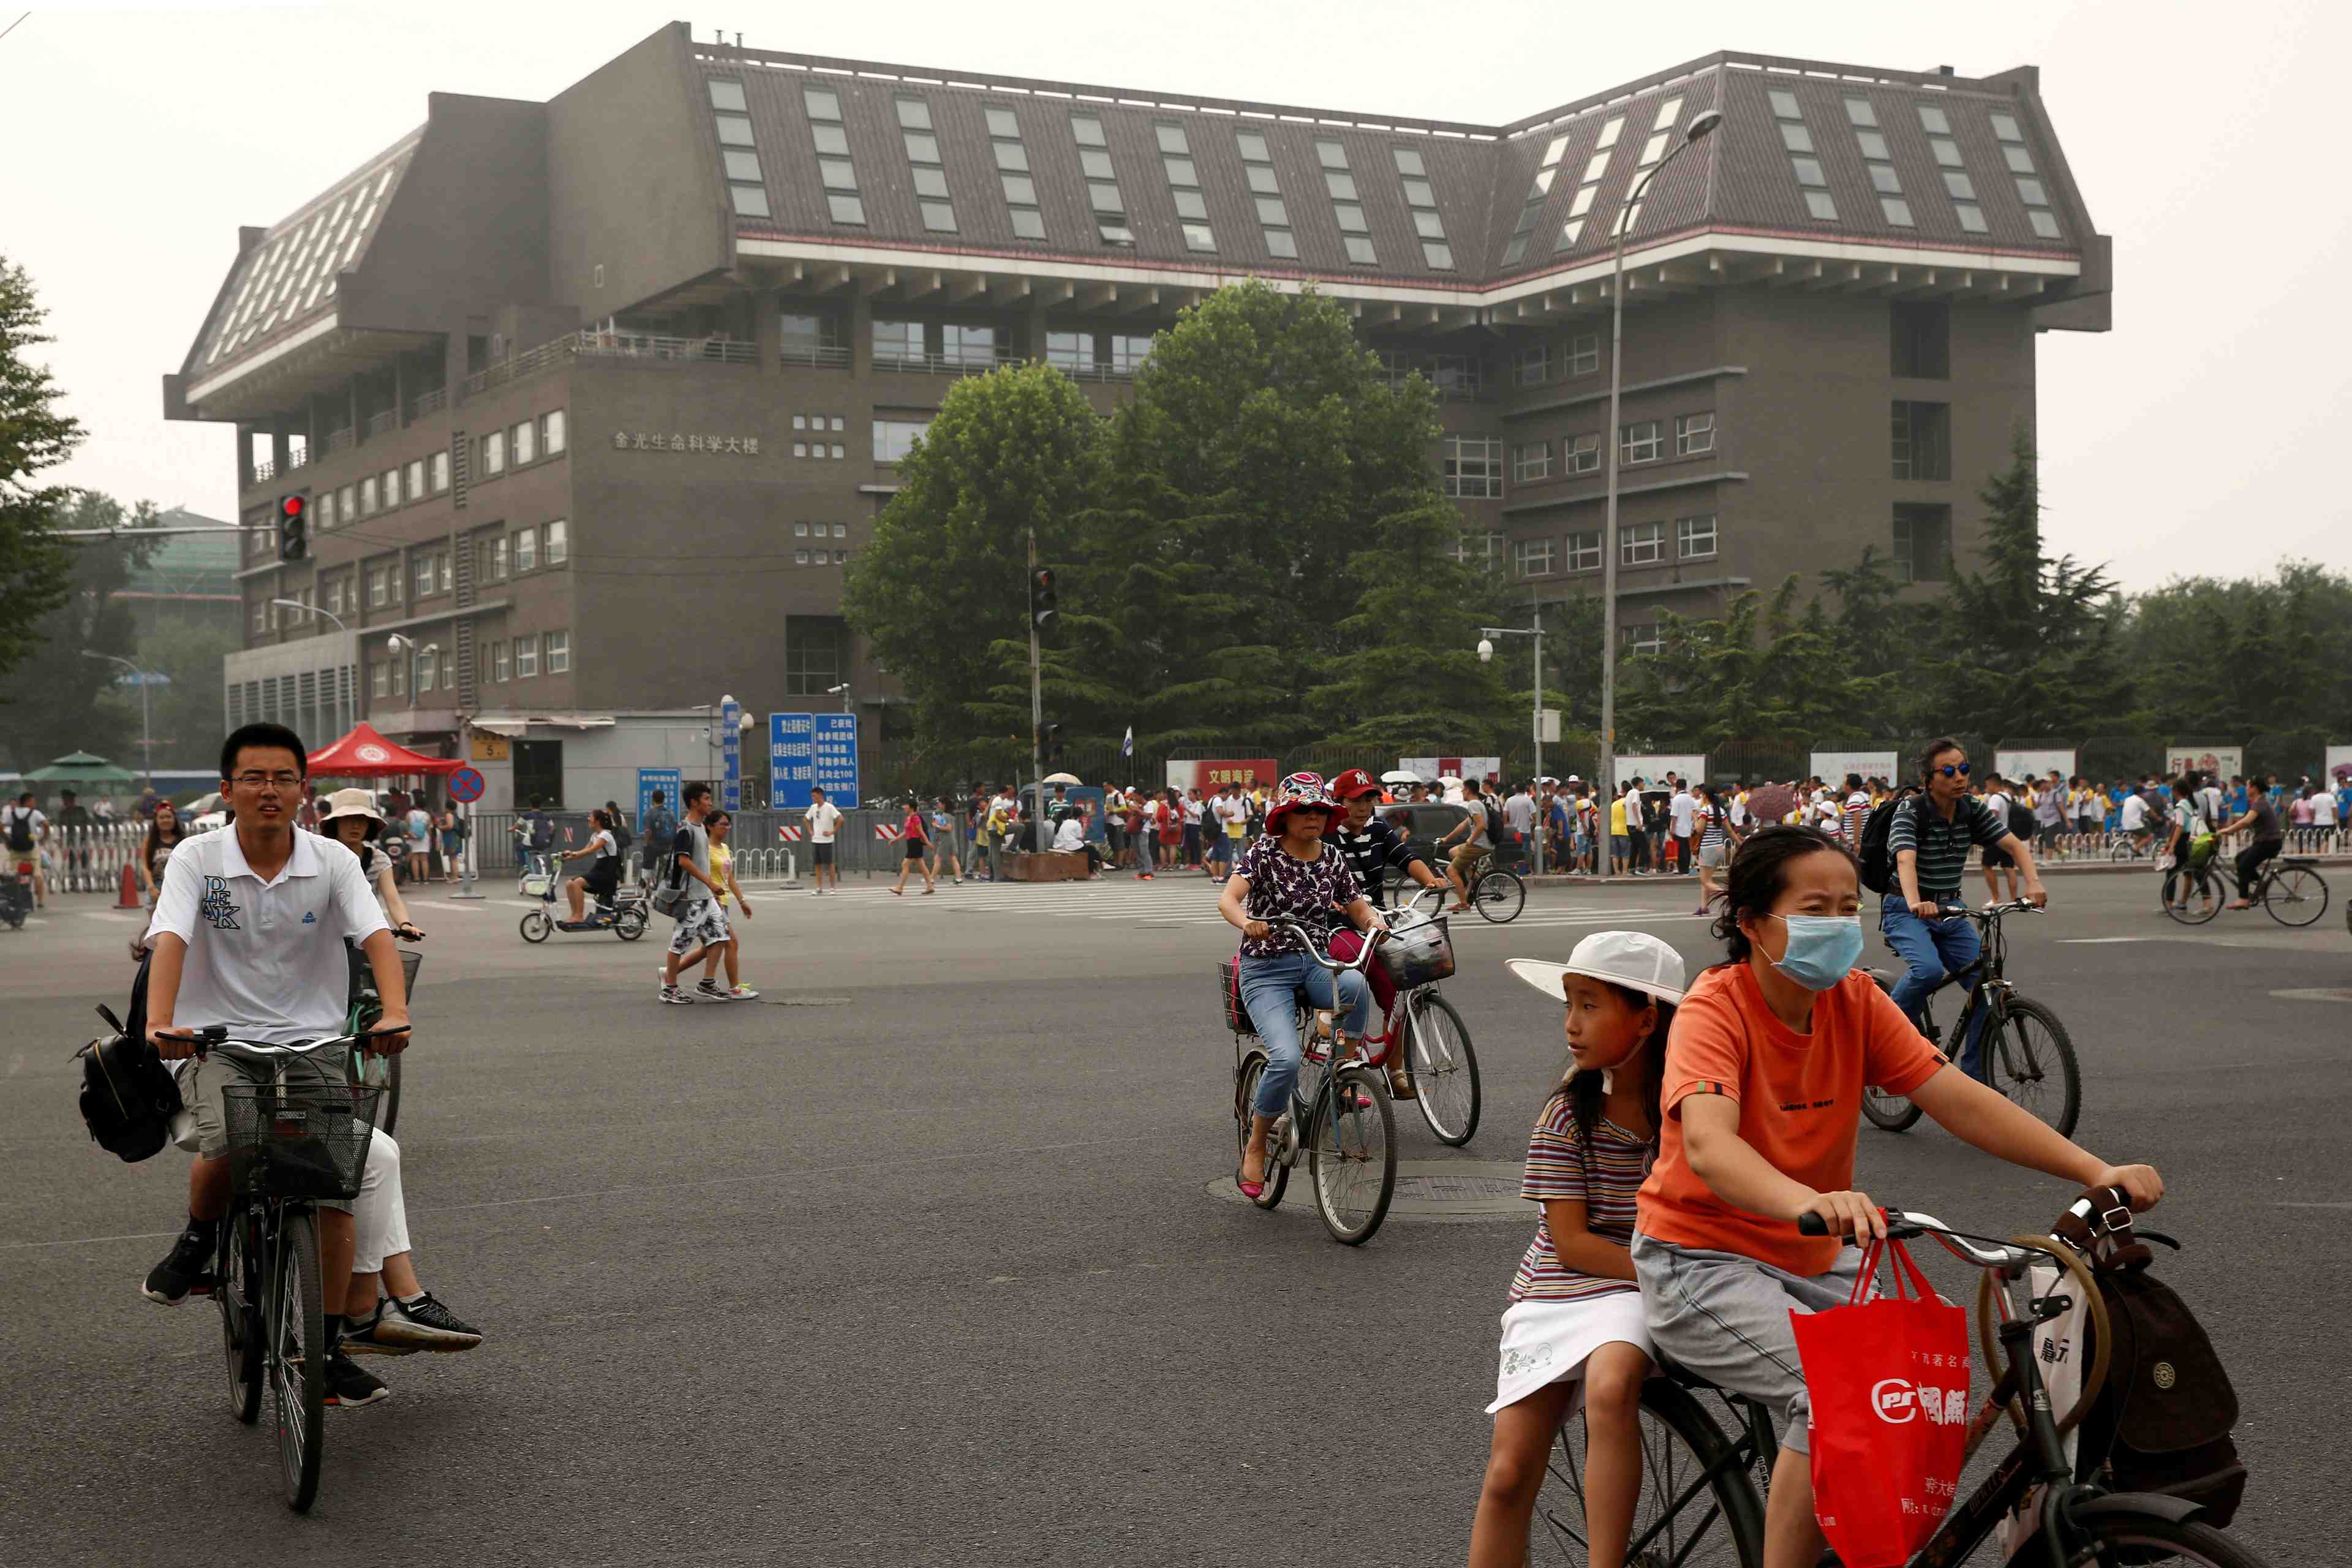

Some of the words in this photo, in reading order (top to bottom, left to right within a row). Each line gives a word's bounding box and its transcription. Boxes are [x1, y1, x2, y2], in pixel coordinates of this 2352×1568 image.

[614, 431, 759, 454] 金光生命科学大楼
[1208, 769, 1254, 784] 文明海淀
[1355, 772, 1370, 785] NY
[203, 875, 241, 930] PEAK
